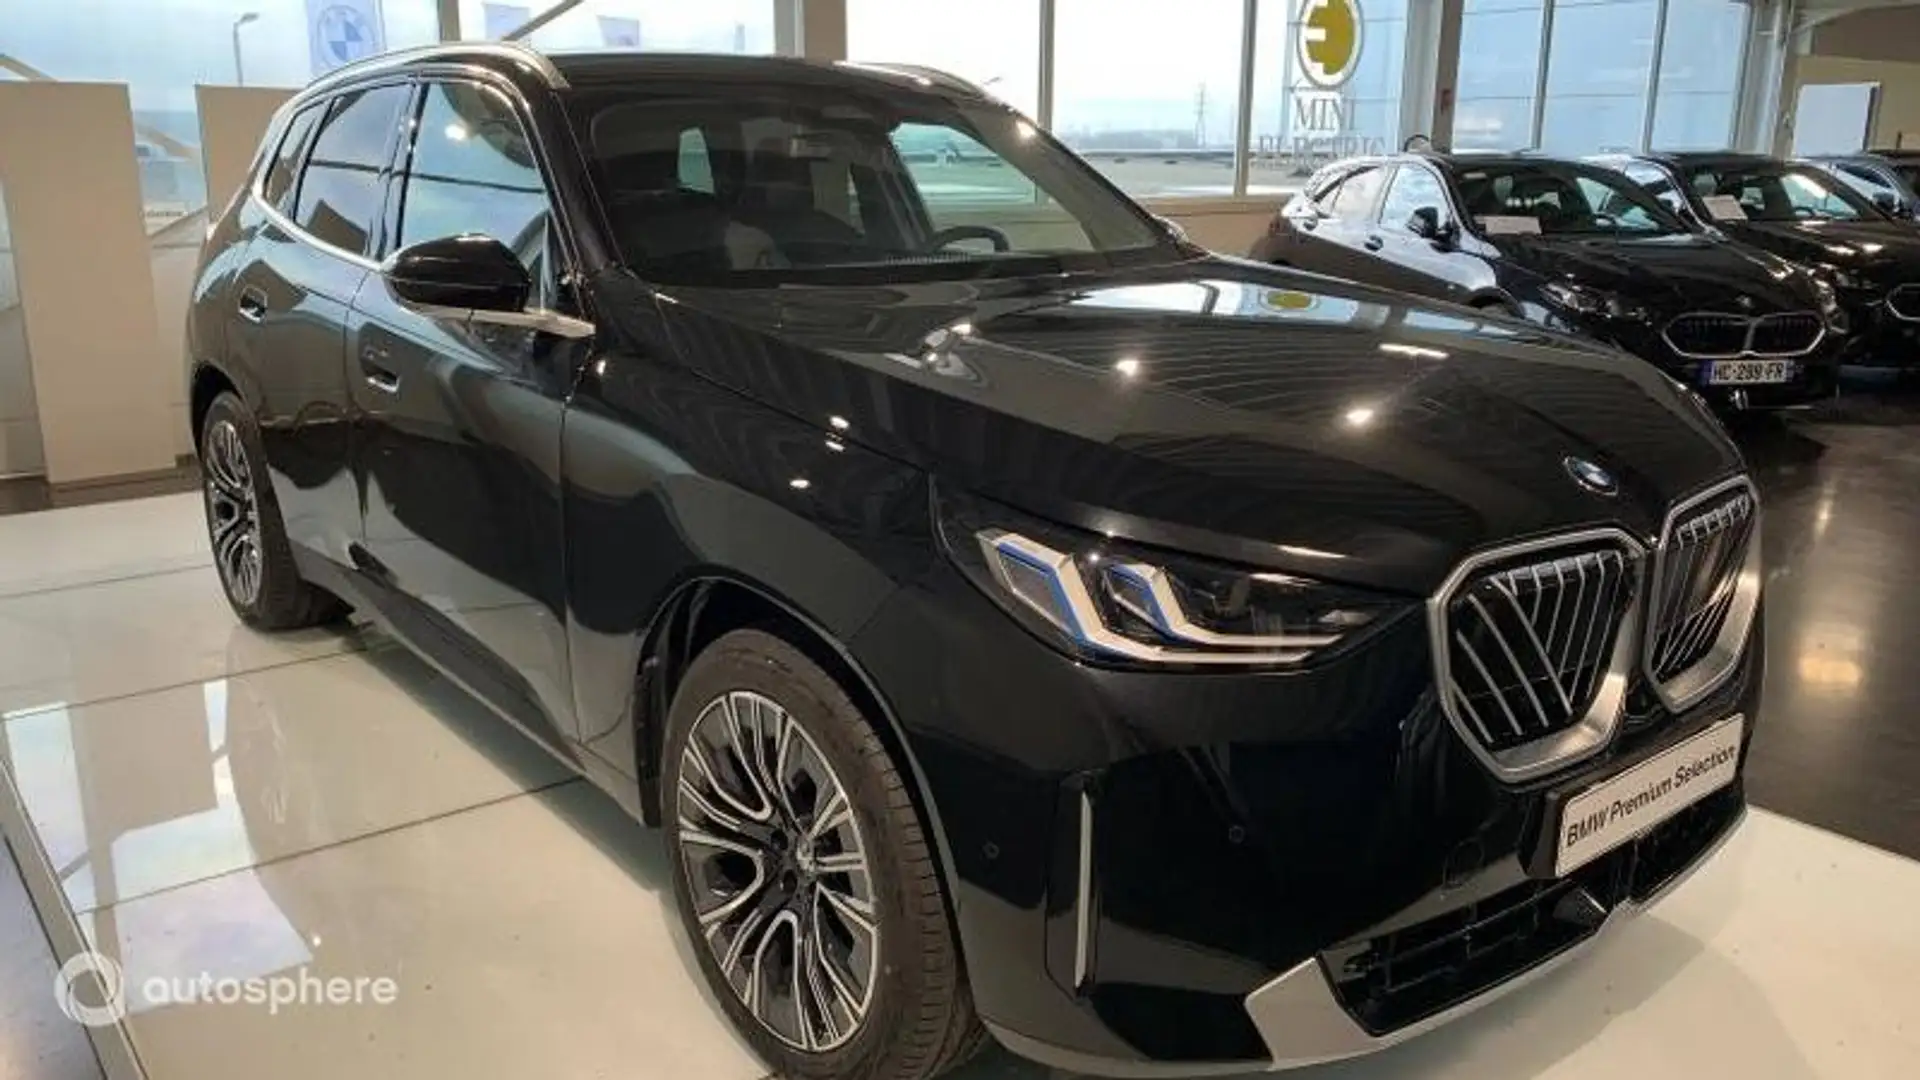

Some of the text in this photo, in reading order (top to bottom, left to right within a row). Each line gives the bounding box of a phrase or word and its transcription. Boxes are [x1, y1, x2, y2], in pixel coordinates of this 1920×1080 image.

[1294, 98, 1359, 131] MINI
[1567, 746, 1736, 847] BMW Premium Selection
